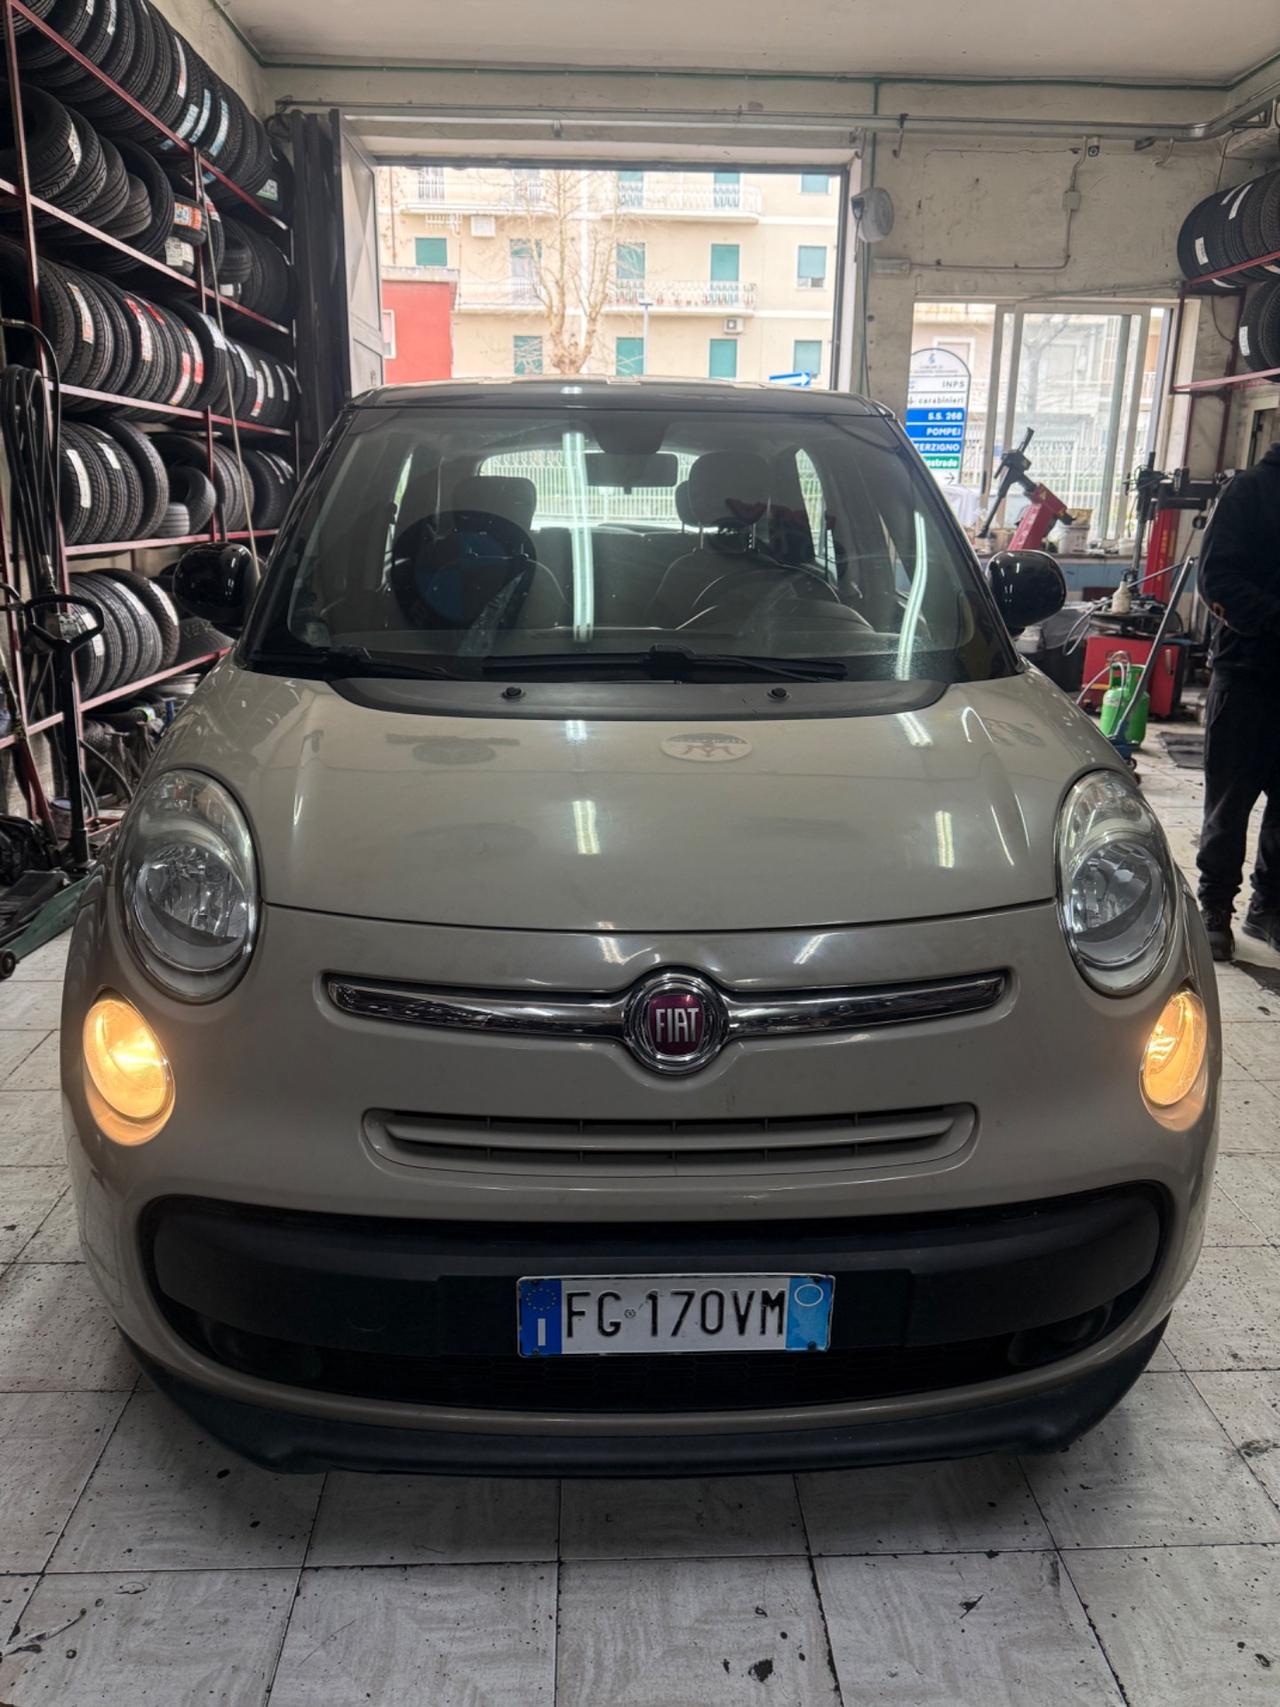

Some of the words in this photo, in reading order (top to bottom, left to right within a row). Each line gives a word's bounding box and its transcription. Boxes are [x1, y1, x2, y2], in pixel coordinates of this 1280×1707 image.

[942, 380, 965, 388] INPS
[926, 427, 961, 436] POMPEI
[914, 443, 960, 452] TERZIGNO
[655, 1007, 699, 1043] FIAT
